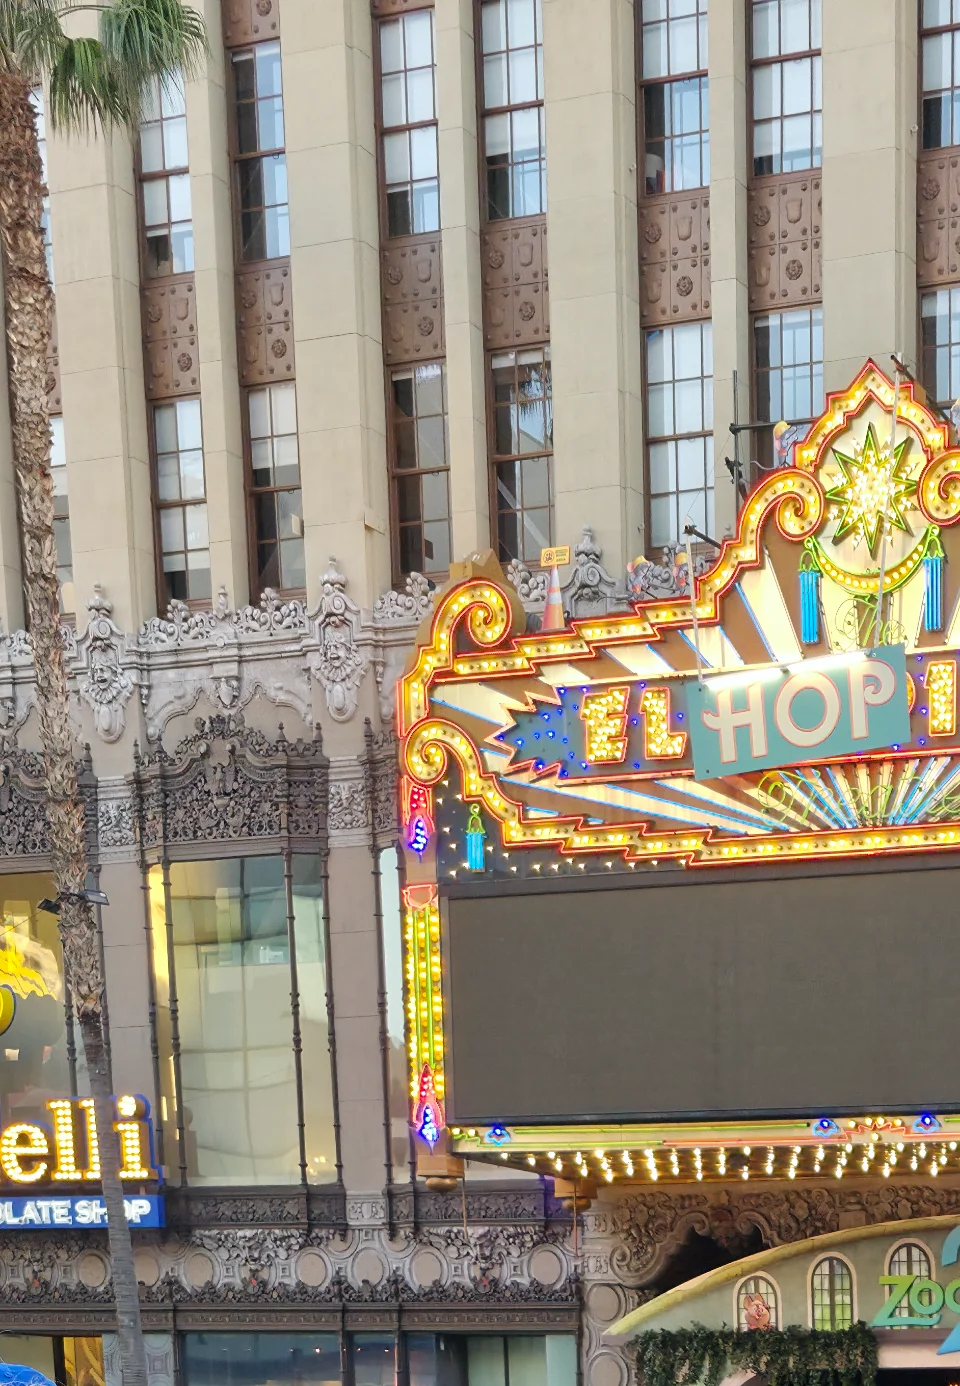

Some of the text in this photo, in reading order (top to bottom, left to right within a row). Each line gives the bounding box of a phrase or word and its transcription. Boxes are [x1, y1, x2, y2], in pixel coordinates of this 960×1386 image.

[578, 683, 688, 766] EL
[703, 655, 898, 765] HOP
[0, 1200, 72, 1225] LATE
